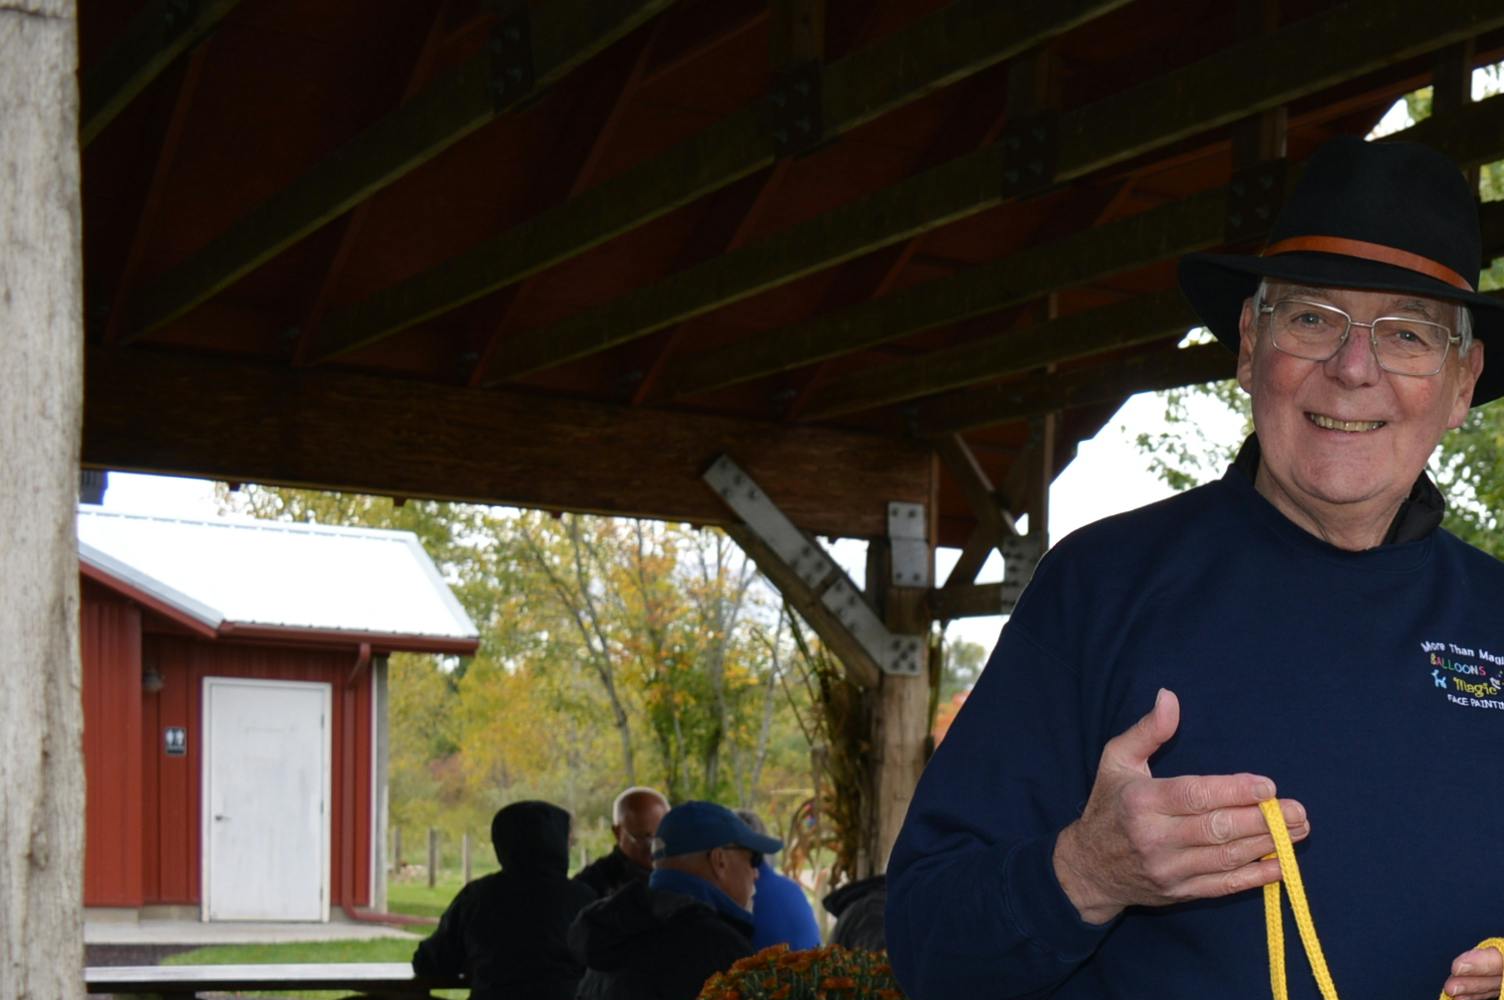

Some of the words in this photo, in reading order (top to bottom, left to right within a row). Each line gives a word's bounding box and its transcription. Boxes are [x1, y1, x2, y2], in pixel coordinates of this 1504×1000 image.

[1421, 641, 1446, 653] More
[1448, 643, 1475, 657] Than
[1430, 653, 1487, 676] BALLOONS
[1453, 677, 1497, 697] Magic
[1447, 694, 1469, 706] FACE
